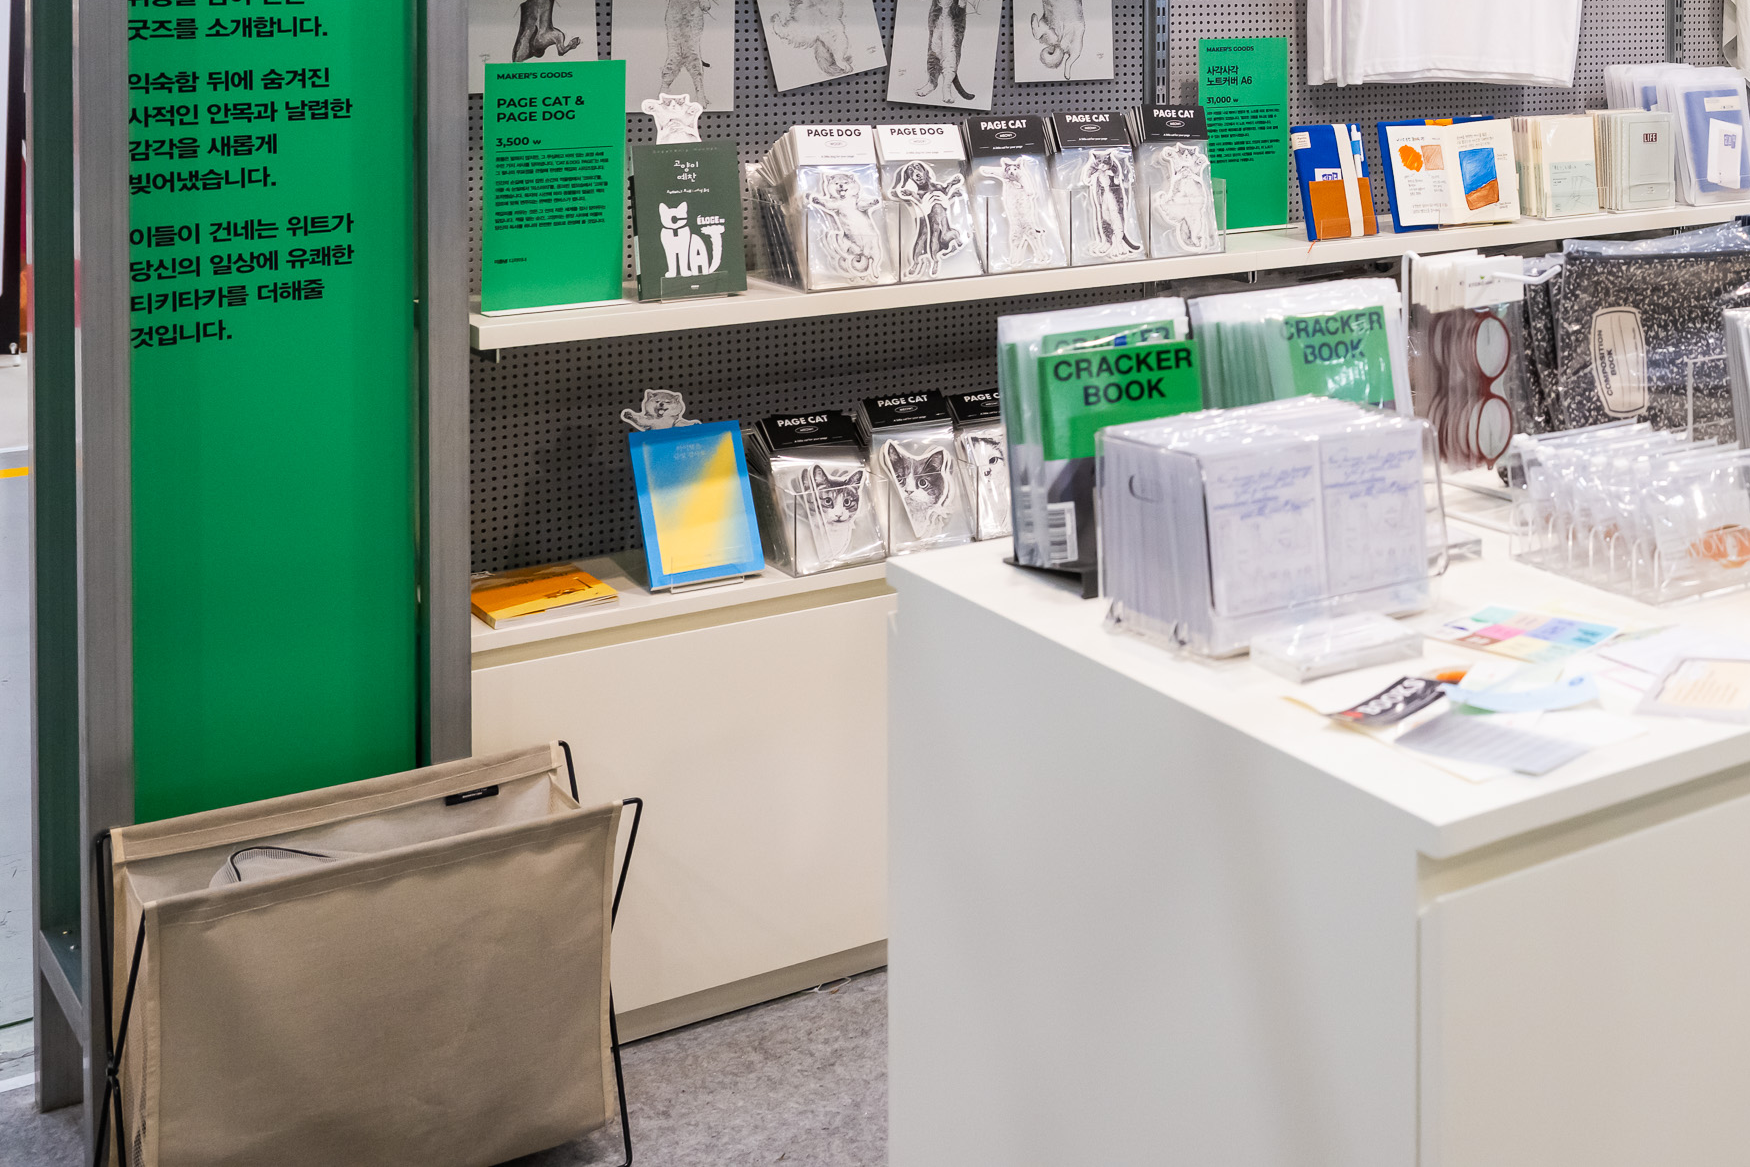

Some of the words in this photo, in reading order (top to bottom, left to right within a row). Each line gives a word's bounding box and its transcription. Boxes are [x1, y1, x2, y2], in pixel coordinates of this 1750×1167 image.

[127, 17, 198, 41] 굿즈를
[205, 16, 328, 38] 소개합니다.
[1207, 65, 1239, 76] 사각사각
[128, 71, 199, 94] 익숙함
[207, 70, 254, 90] 뒤에
[261, 67, 329, 89] 숨겨진
[1207, 76, 1238, 86] 노트커버
[1241, 76, 1252, 85] A6
[497, 97, 537, 108] PAGE
[542, 96, 571, 107] CAT
[575, 96, 584, 105] &
[1206, 96, 1231, 104] 31,000
[129, 103, 199, 128] 사적인
[207, 101, 278, 125] 안목과
[284, 98, 353, 120] 날렵한
[497, 112, 537, 122] PAGE
[542, 110, 575, 121] DOG
[1065, 115, 1090, 123] PAGE
[1092, 114, 1110, 122] CAT
[1153, 110, 1177, 118] PAGE
[1178, 110, 1194, 118] CAT
[981, 121, 1006, 130] PAGE
[1008, 120, 1027, 128] CAT
[496, 137, 529, 147] 3,500
[1644, 134, 1657, 142] LIFE
[129, 137, 200, 161] 감각을
[208, 134, 277, 156] 새롭게
[674, 160, 698, 172] 고양이
[129, 166, 276, 195] 빚어냈습니다.
[130, 223, 200, 247] 이들이
[209, 219, 278, 242] 건네는
[286, 213, 354, 236] 위트가
[130, 256, 200, 282] 당신의
[209, 250, 278, 275] 일상에
[286, 244, 354, 268] 유쾌한
[131, 285, 249, 314] 티키타카를
[257, 279, 325, 303] 더해줄
[131, 320, 232, 348] 것입니다.
[1281, 312, 1383, 341] CRACKER
[1303, 338, 1366, 364] BOOK
[1053, 347, 1193, 381] CRACKER
[1607, 348, 1616, 375] BOOK
[964, 393, 991, 402] PAGE
[1083, 377, 1166, 406] BOOK
[877, 397, 905, 407] PAGE
[908, 395, 928, 403] CAT
[777, 417, 806, 427] PAGE
[808, 415, 828, 424] CAT
